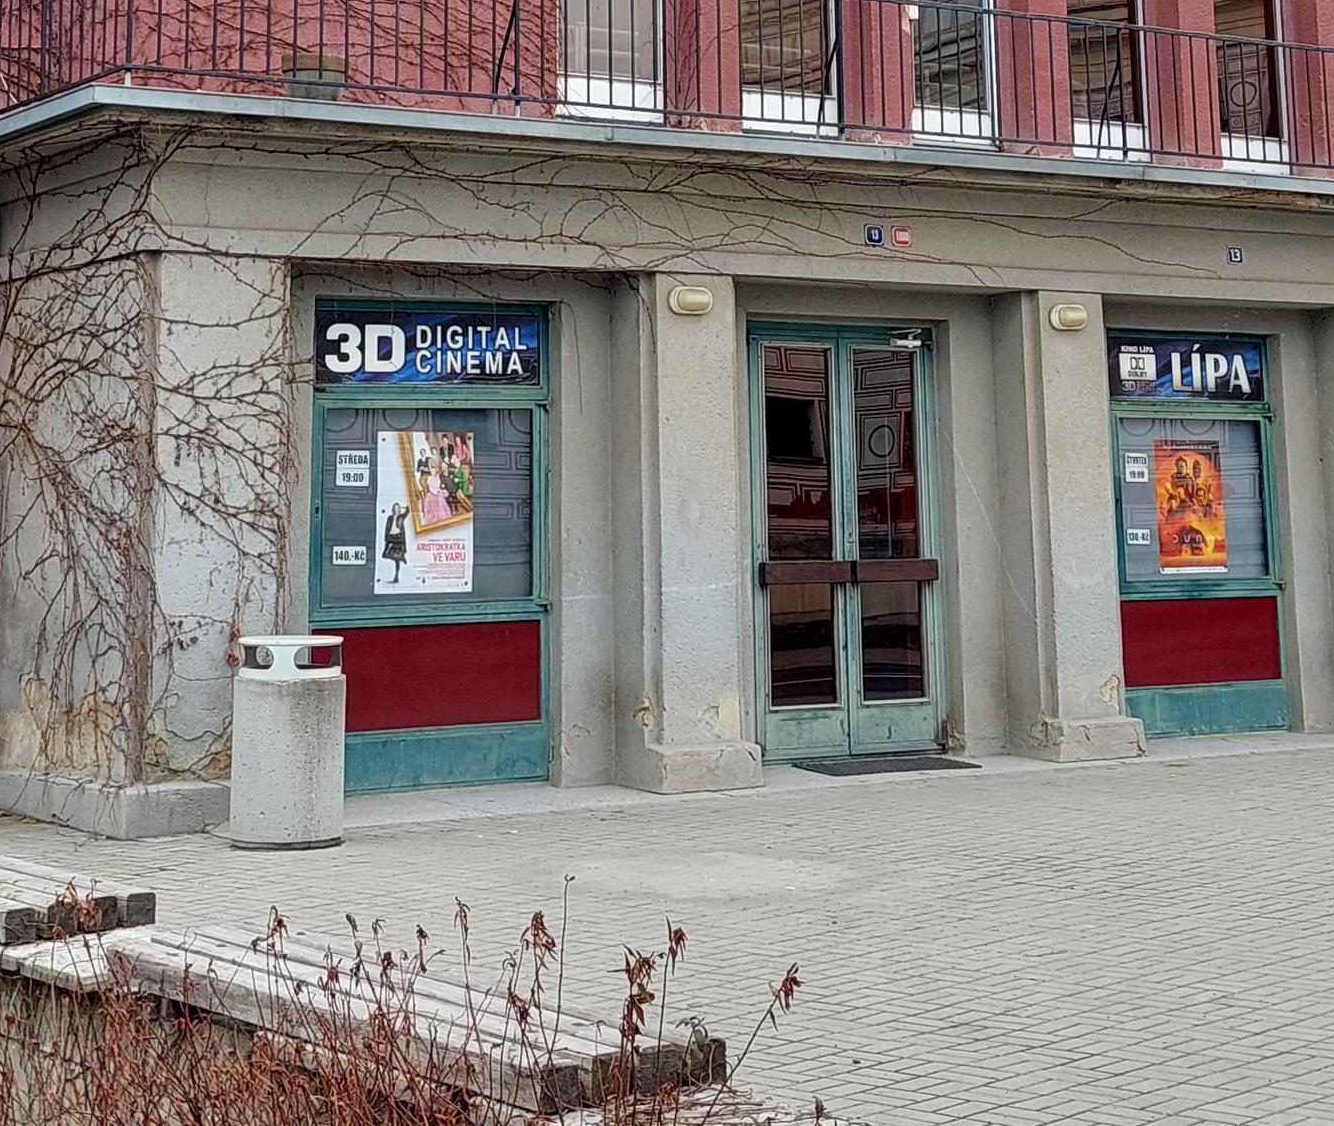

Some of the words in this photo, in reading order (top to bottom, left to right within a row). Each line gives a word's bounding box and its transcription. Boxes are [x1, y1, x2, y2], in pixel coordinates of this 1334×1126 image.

[1230, 248, 1241, 261] 13
[417, 325, 528, 350] DIGITAL
[324, 323, 406, 373] 3D
[1120, 345, 1138, 353] KINO
[416, 350, 524, 375] CINEMA
[1170, 343, 1252, 394] LÍPA
[1121, 381, 1136, 392] 3D
[338, 453, 369, 465] STŘEDA
[342, 472, 364, 483] 19:00
[416, 543, 467, 552] ARISTOKRATKA
[432, 552, 444, 563] VE
[444, 551, 466, 562] VARU
